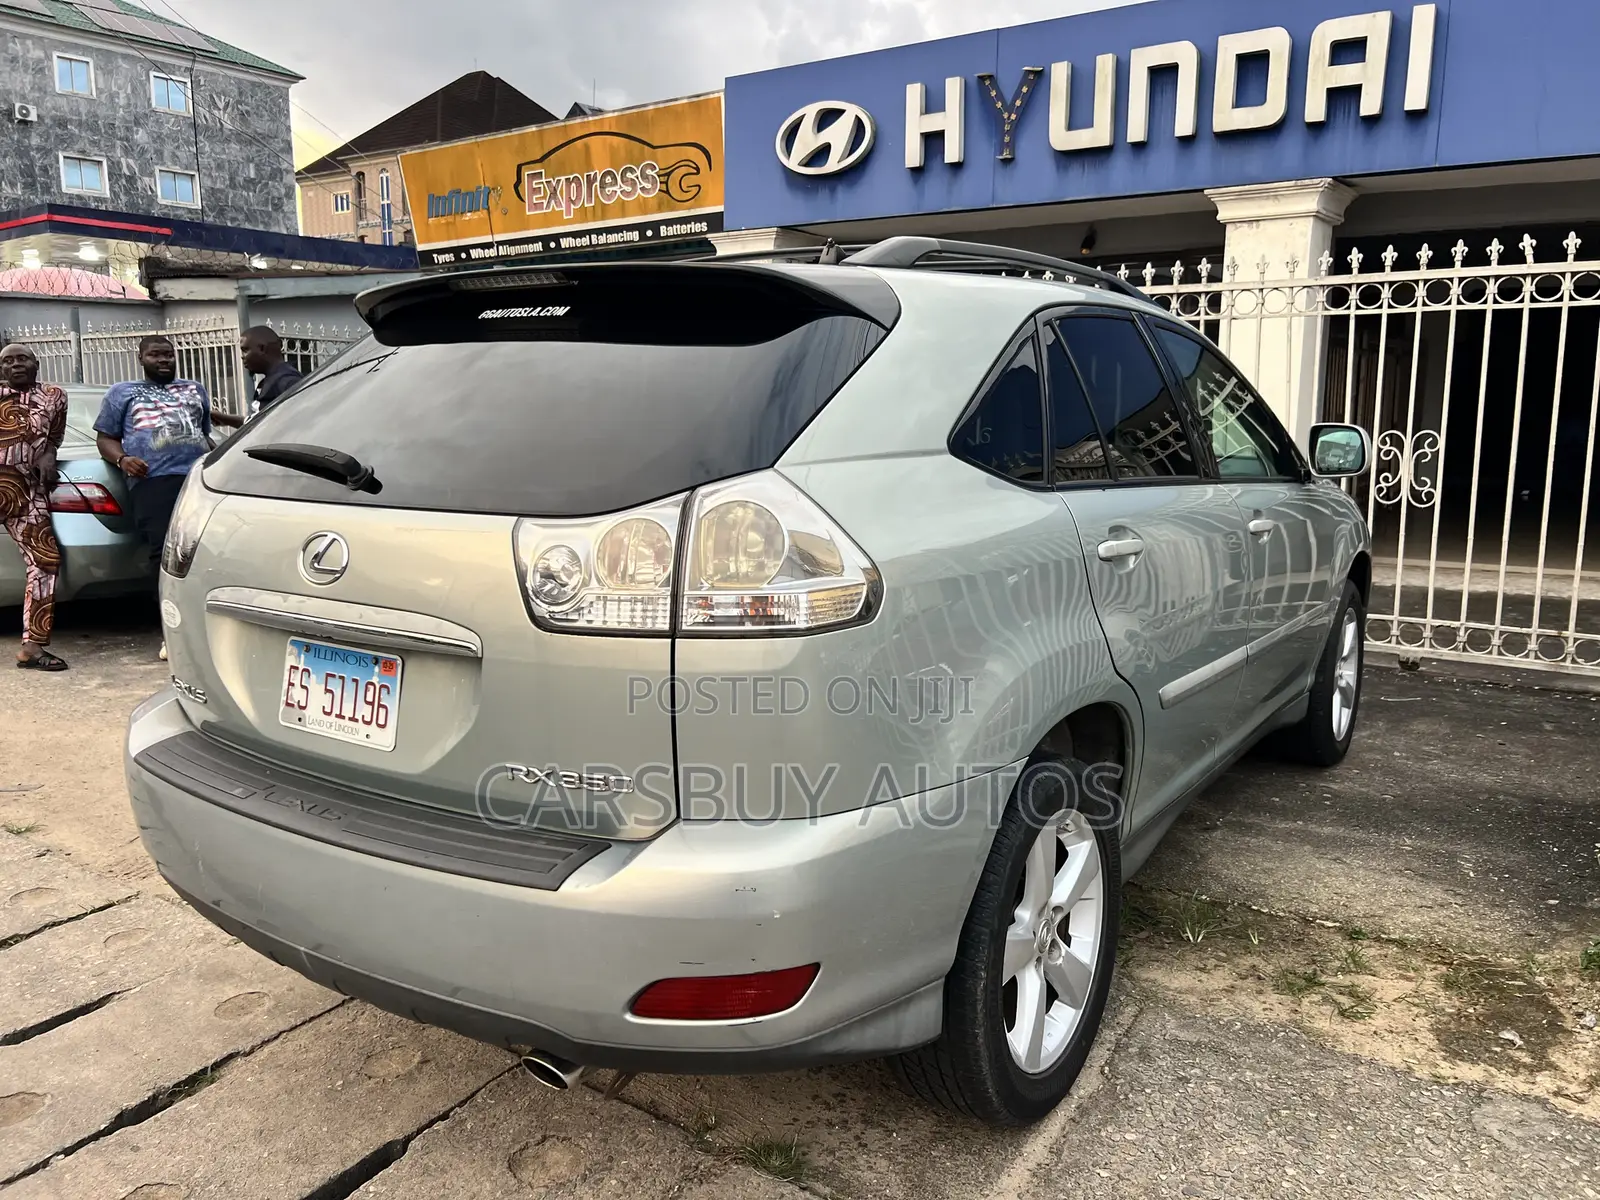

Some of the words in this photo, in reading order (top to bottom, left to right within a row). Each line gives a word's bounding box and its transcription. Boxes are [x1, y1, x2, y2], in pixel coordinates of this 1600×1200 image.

[904, 3, 1437, 170] HYUNDAI
[427, 185, 502, 219] Infinit
[525, 161, 660, 219] Express
[432, 253, 455, 264] Tyres
[469, 244, 498, 260] Wheel
[498, 241, 543, 257] Alignment
[559, 233, 591, 249] Wheel
[590, 229, 640, 246] Balancing
[659, 221, 709, 238] Batteries
[313, 647, 369, 669] ILLINOIS
[285, 665, 311, 711] ES
[322, 672, 391, 729] 51196
[504, 763, 636, 793] RX350
